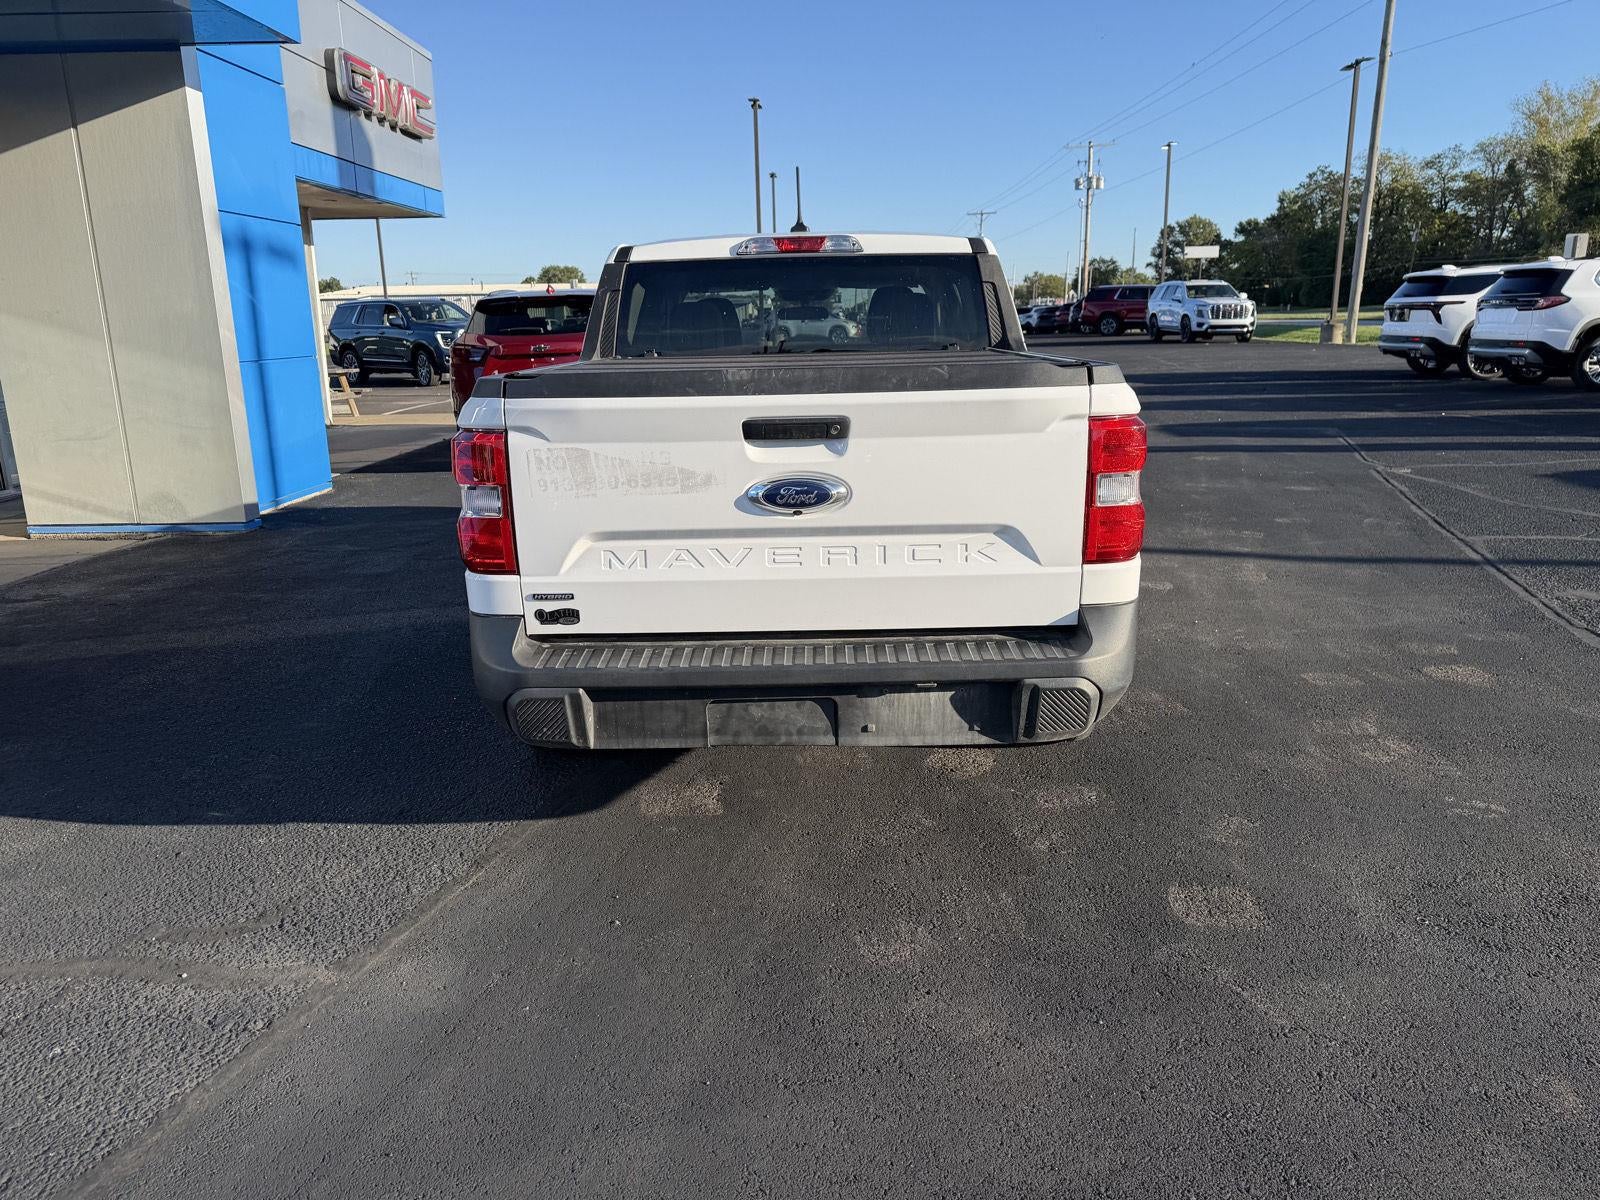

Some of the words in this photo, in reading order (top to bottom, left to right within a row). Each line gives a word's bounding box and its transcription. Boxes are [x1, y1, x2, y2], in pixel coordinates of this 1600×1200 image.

[339, 51, 435, 139] GMC
[776, 486, 818, 504] Ford
[600, 542, 998, 570] MAVERICK
[536, 609, 580, 621] OLATHE
